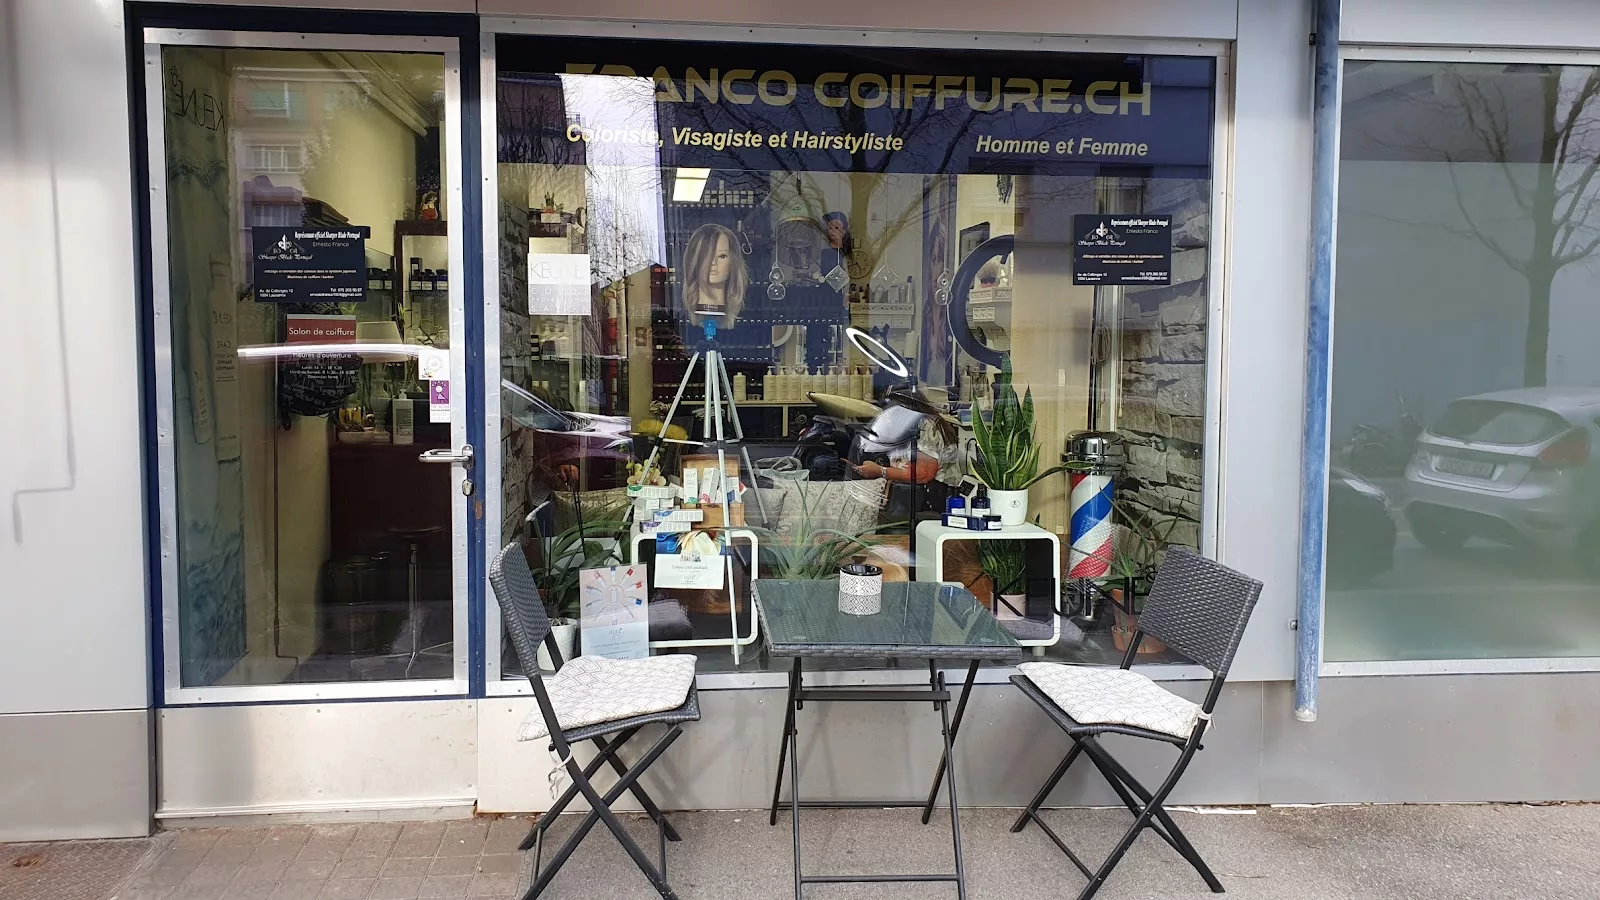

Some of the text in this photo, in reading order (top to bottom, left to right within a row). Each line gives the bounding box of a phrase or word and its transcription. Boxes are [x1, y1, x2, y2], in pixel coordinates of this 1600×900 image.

[813, 71, 1152, 116] COIFFURE.CH
[566, 123, 904, 154] Coloriste, Visagiste et Hairstyliste
[976, 135, 1149, 157] Homme et Femme
[288, 327, 355, 336] Salon de coiffure
[316, 351, 352, 359] d'ouverture
[993, 576, 1148, 618] KEUNE
